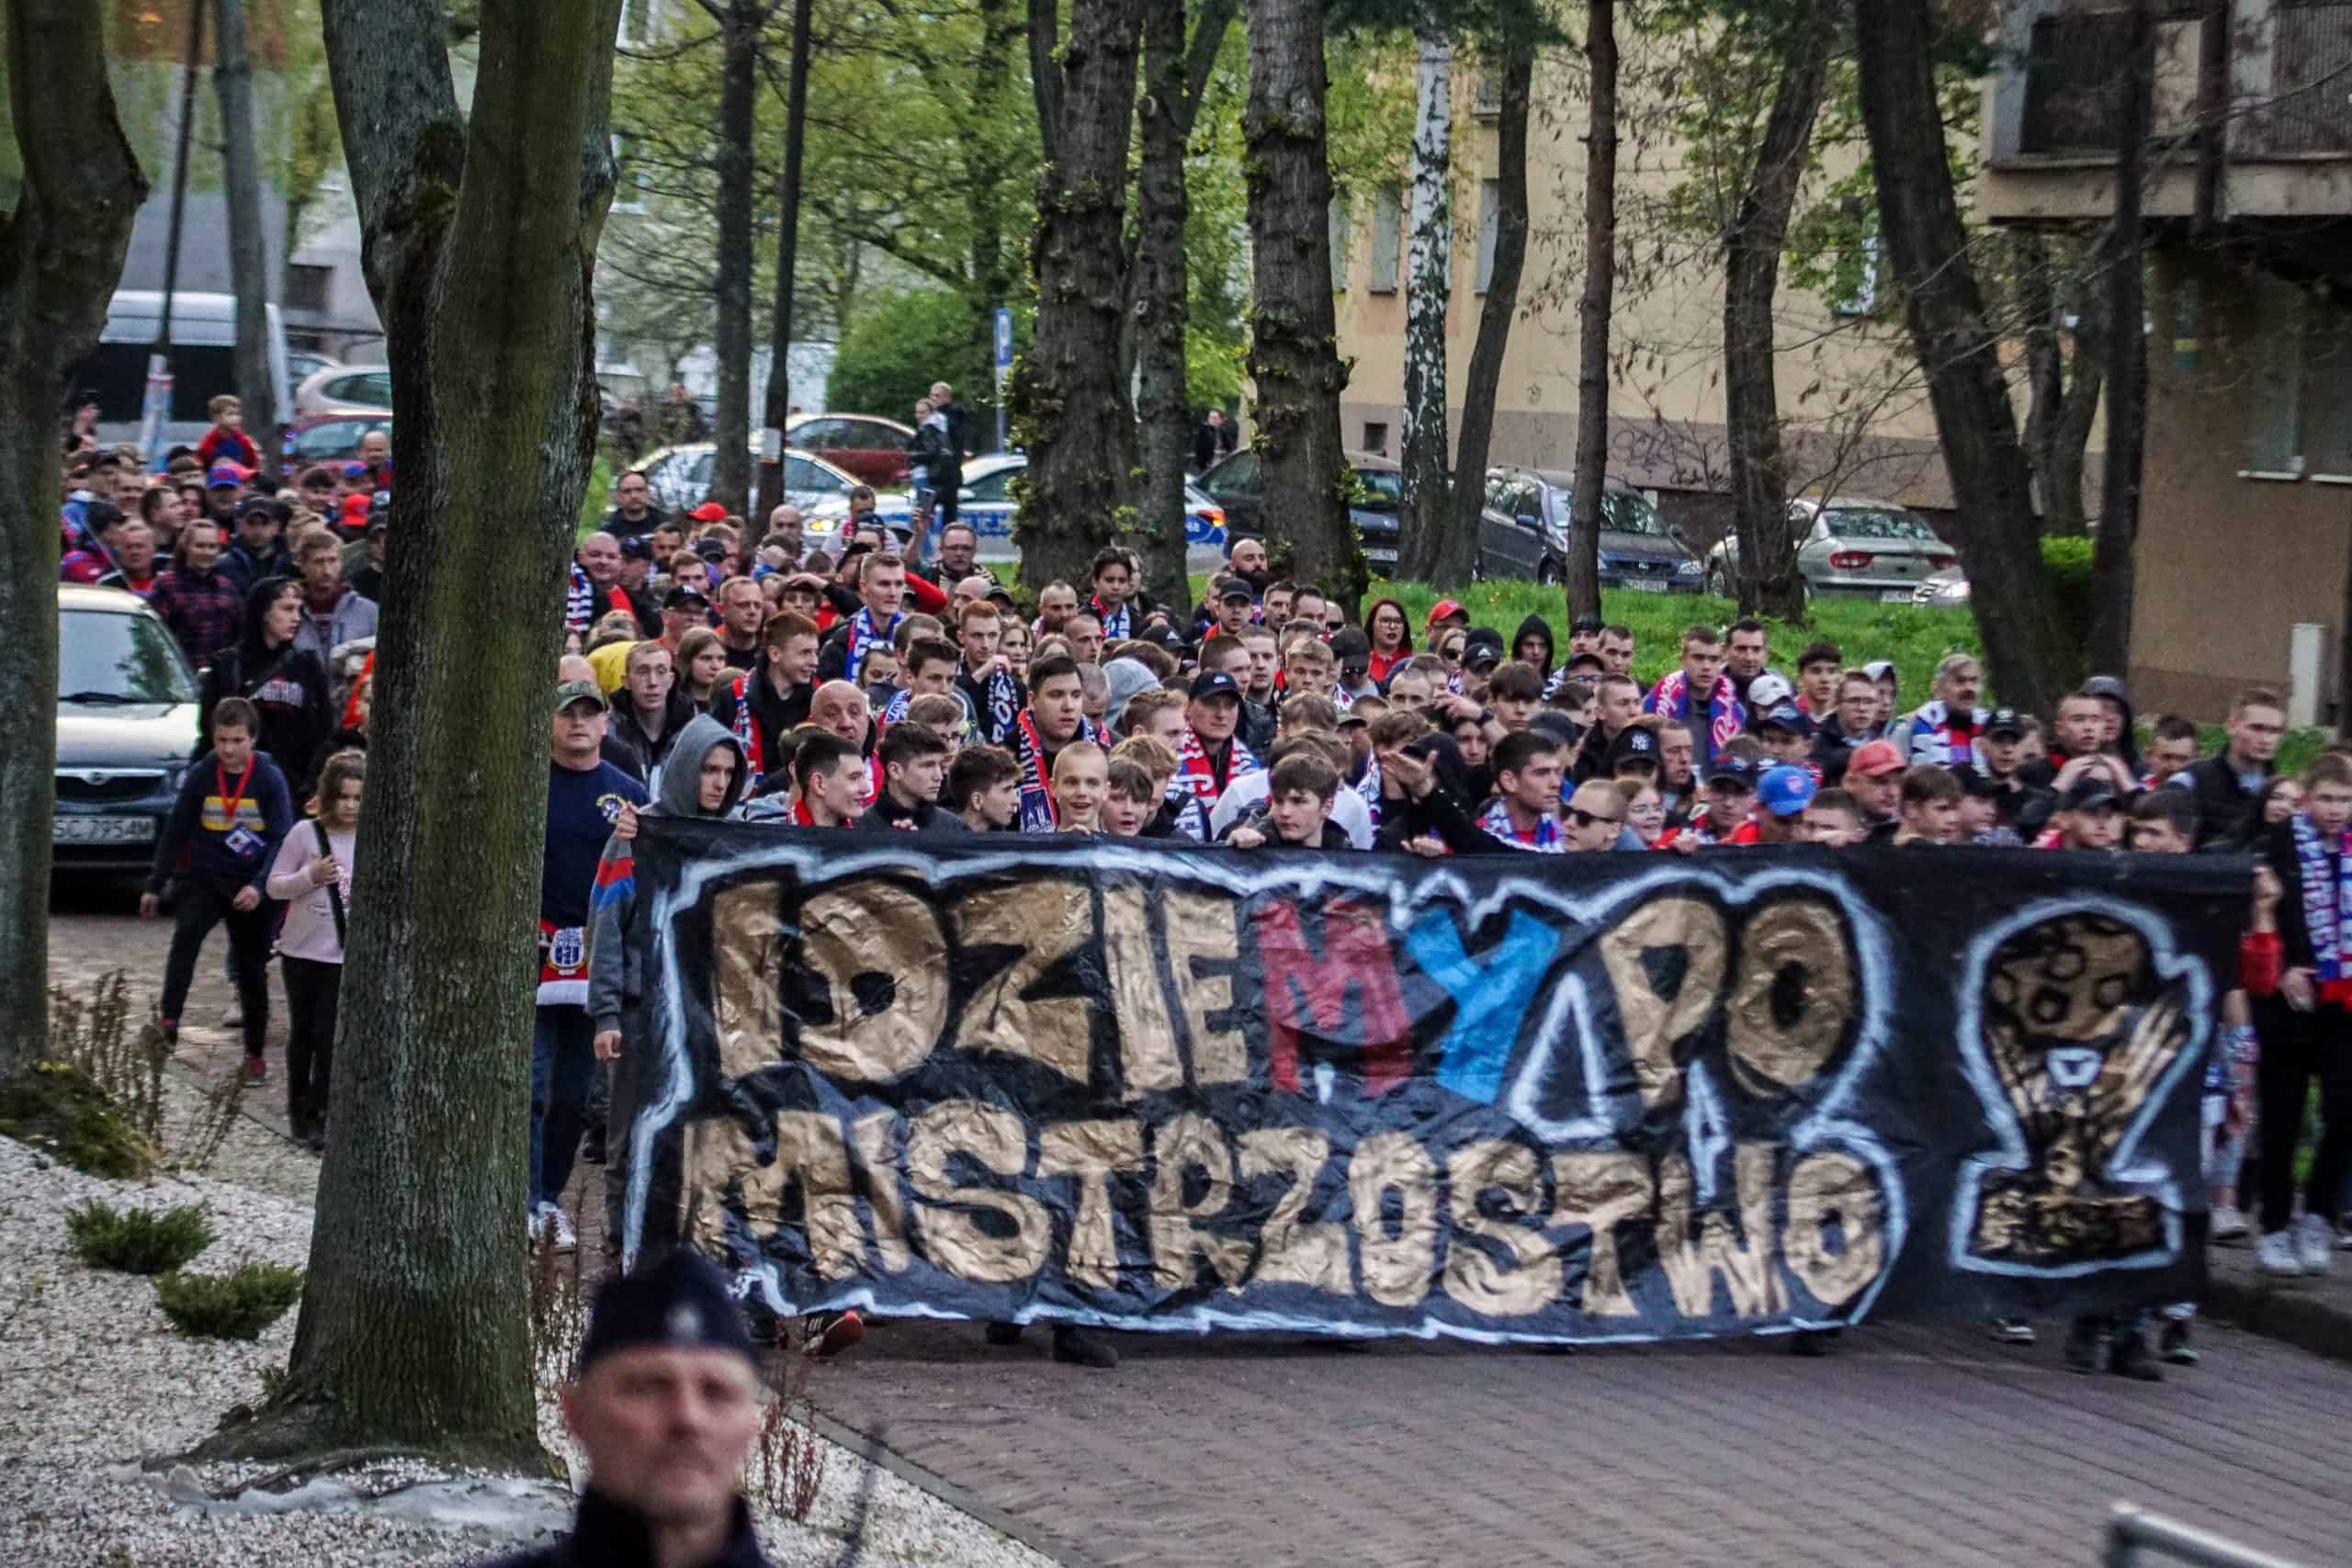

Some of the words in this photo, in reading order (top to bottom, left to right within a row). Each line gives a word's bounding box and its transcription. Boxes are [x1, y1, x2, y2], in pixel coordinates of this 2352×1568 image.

[712, 876, 1561, 1104] IDZIEMY
[1600, 897, 1852, 1108] PO
[678, 1099, 1887, 1319] MISTRZOSTWO
